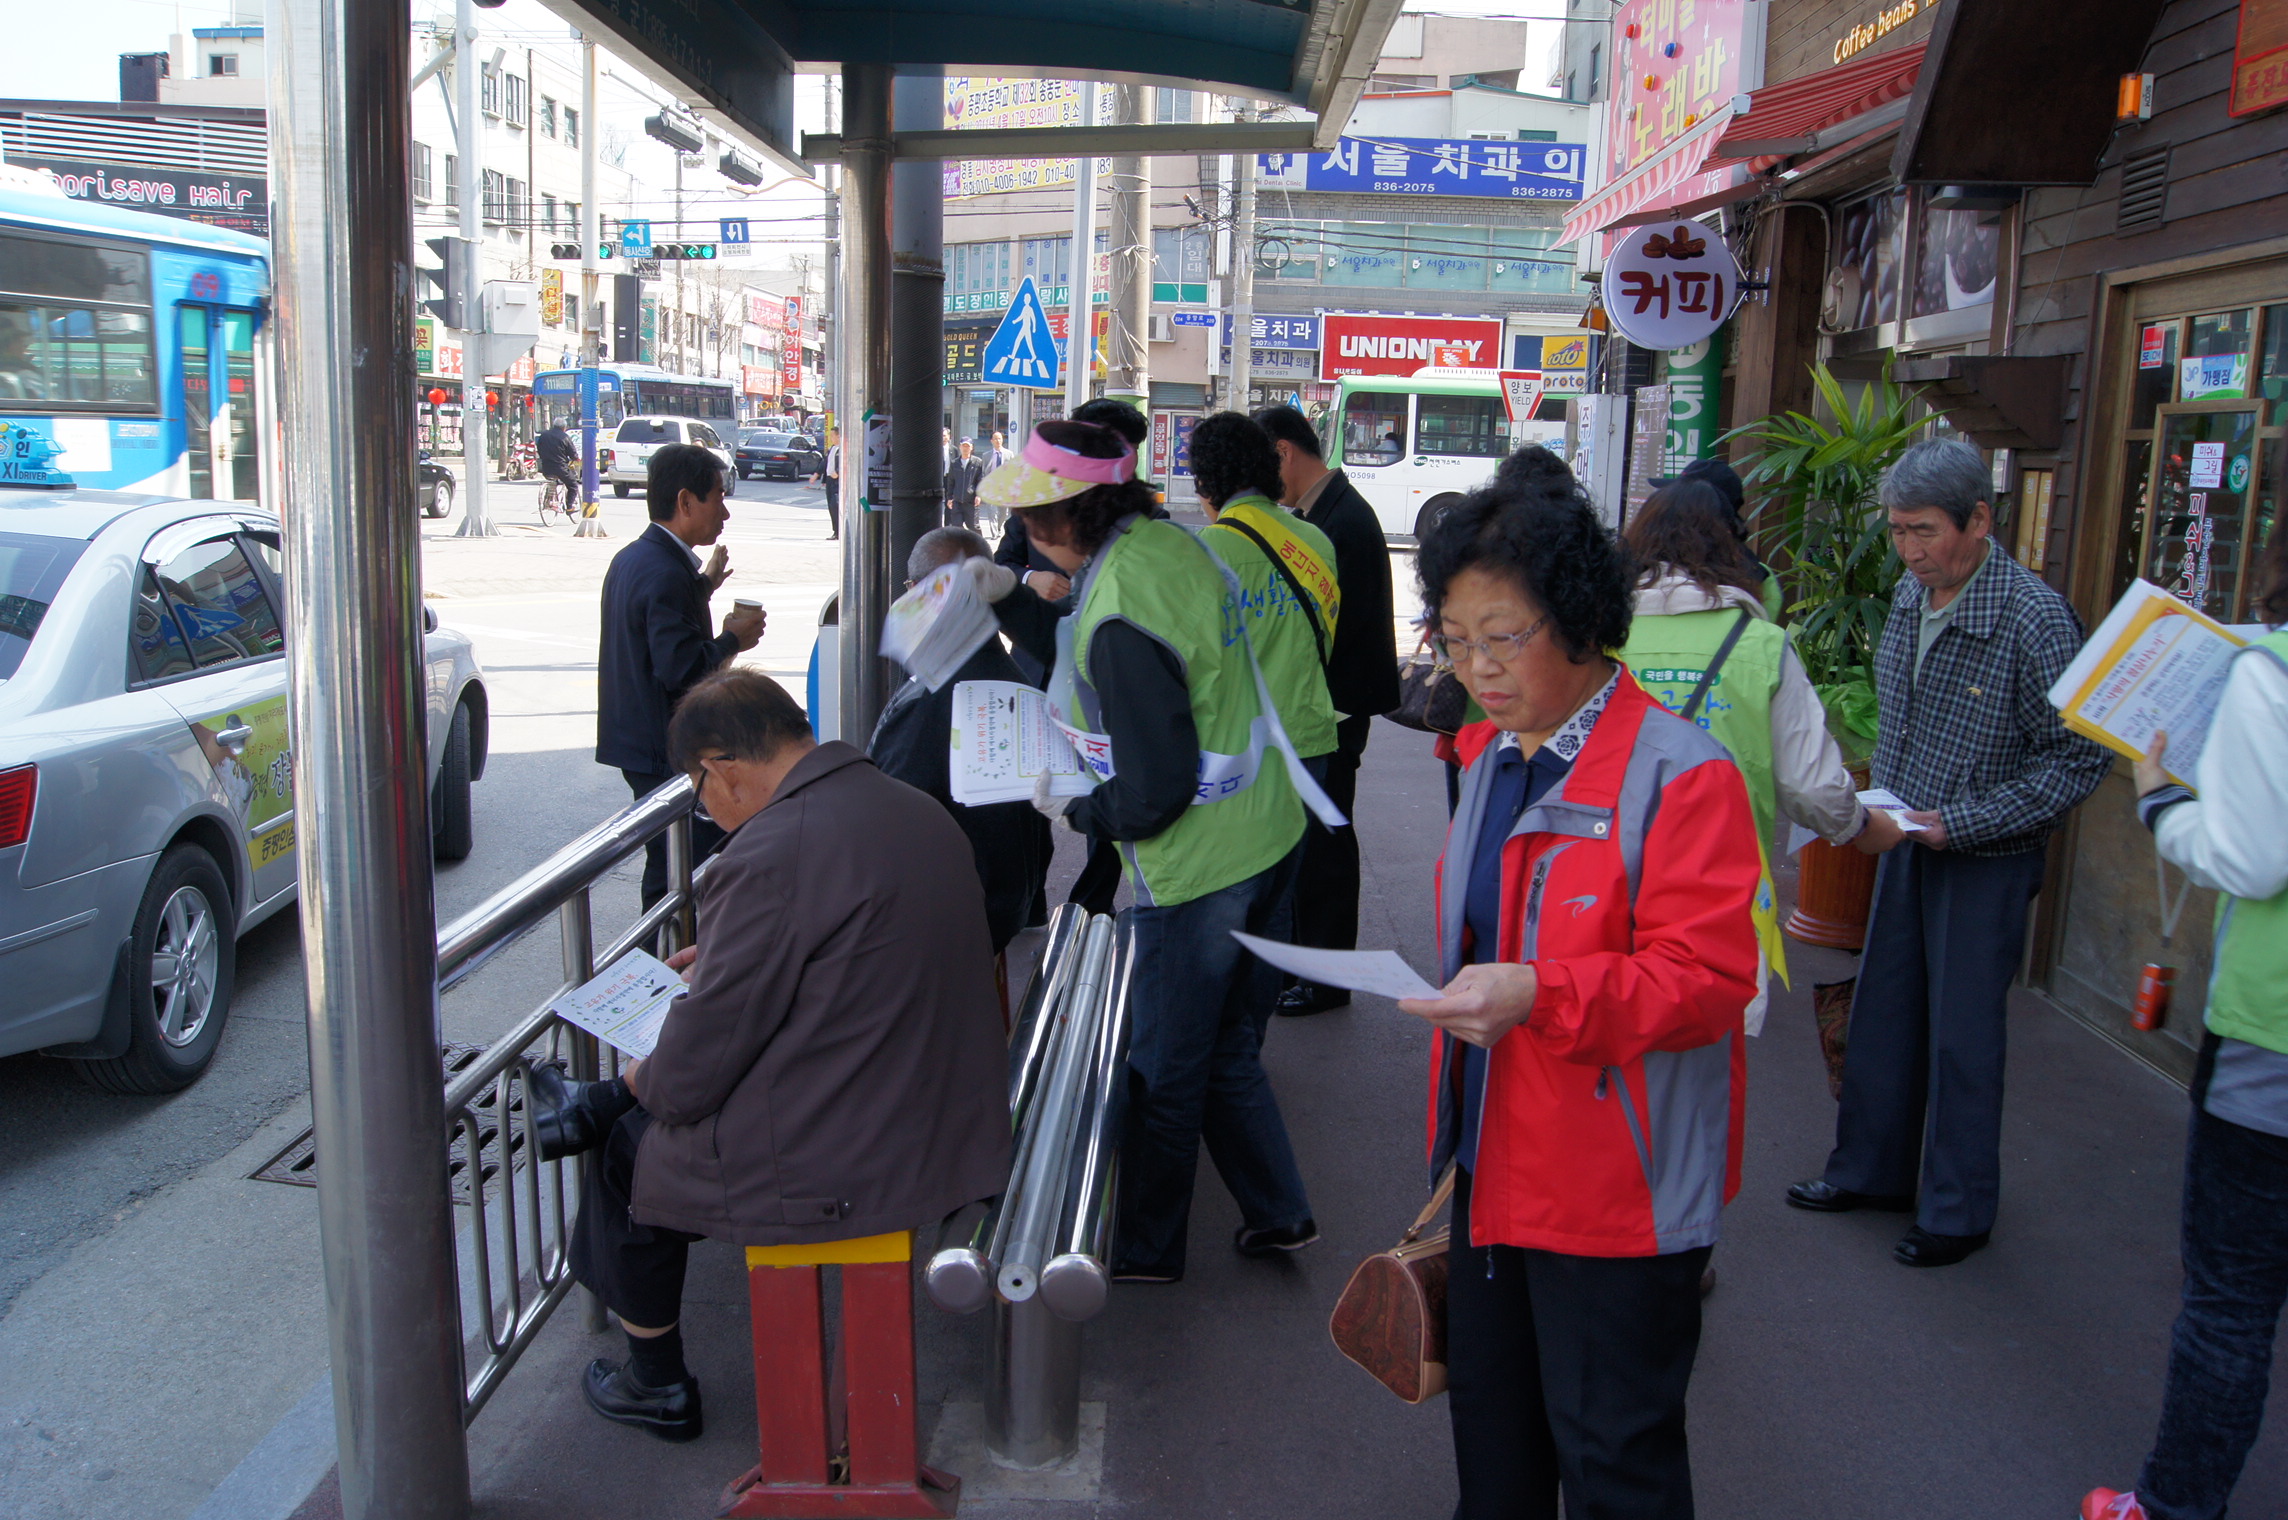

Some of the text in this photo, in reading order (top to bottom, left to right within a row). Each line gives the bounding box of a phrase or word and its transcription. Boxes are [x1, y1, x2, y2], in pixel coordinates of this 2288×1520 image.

[1833, 0, 1919, 65] Coffee beans
[1012, 81, 1037, 106] 제32회
[1630, 36, 1727, 168] 노래방
[1029, 104, 1059, 126] 오전10시
[1373, 181, 1436, 193] 836-2075
[1511, 186, 1574, 199] 836-2875
[189, 181, 253, 210] Hair
[1619, 271, 1724, 321] 커피
[958, 333, 978, 341] QUEEN
[1543, 375, 1585, 390] proto
[2202, 368, 2231, 386] 가맹점
[1511, 381, 1533, 395] 양보
[1510, 396, 1531, 406] YIELD
[19, 472, 47, 481] DRIVER
